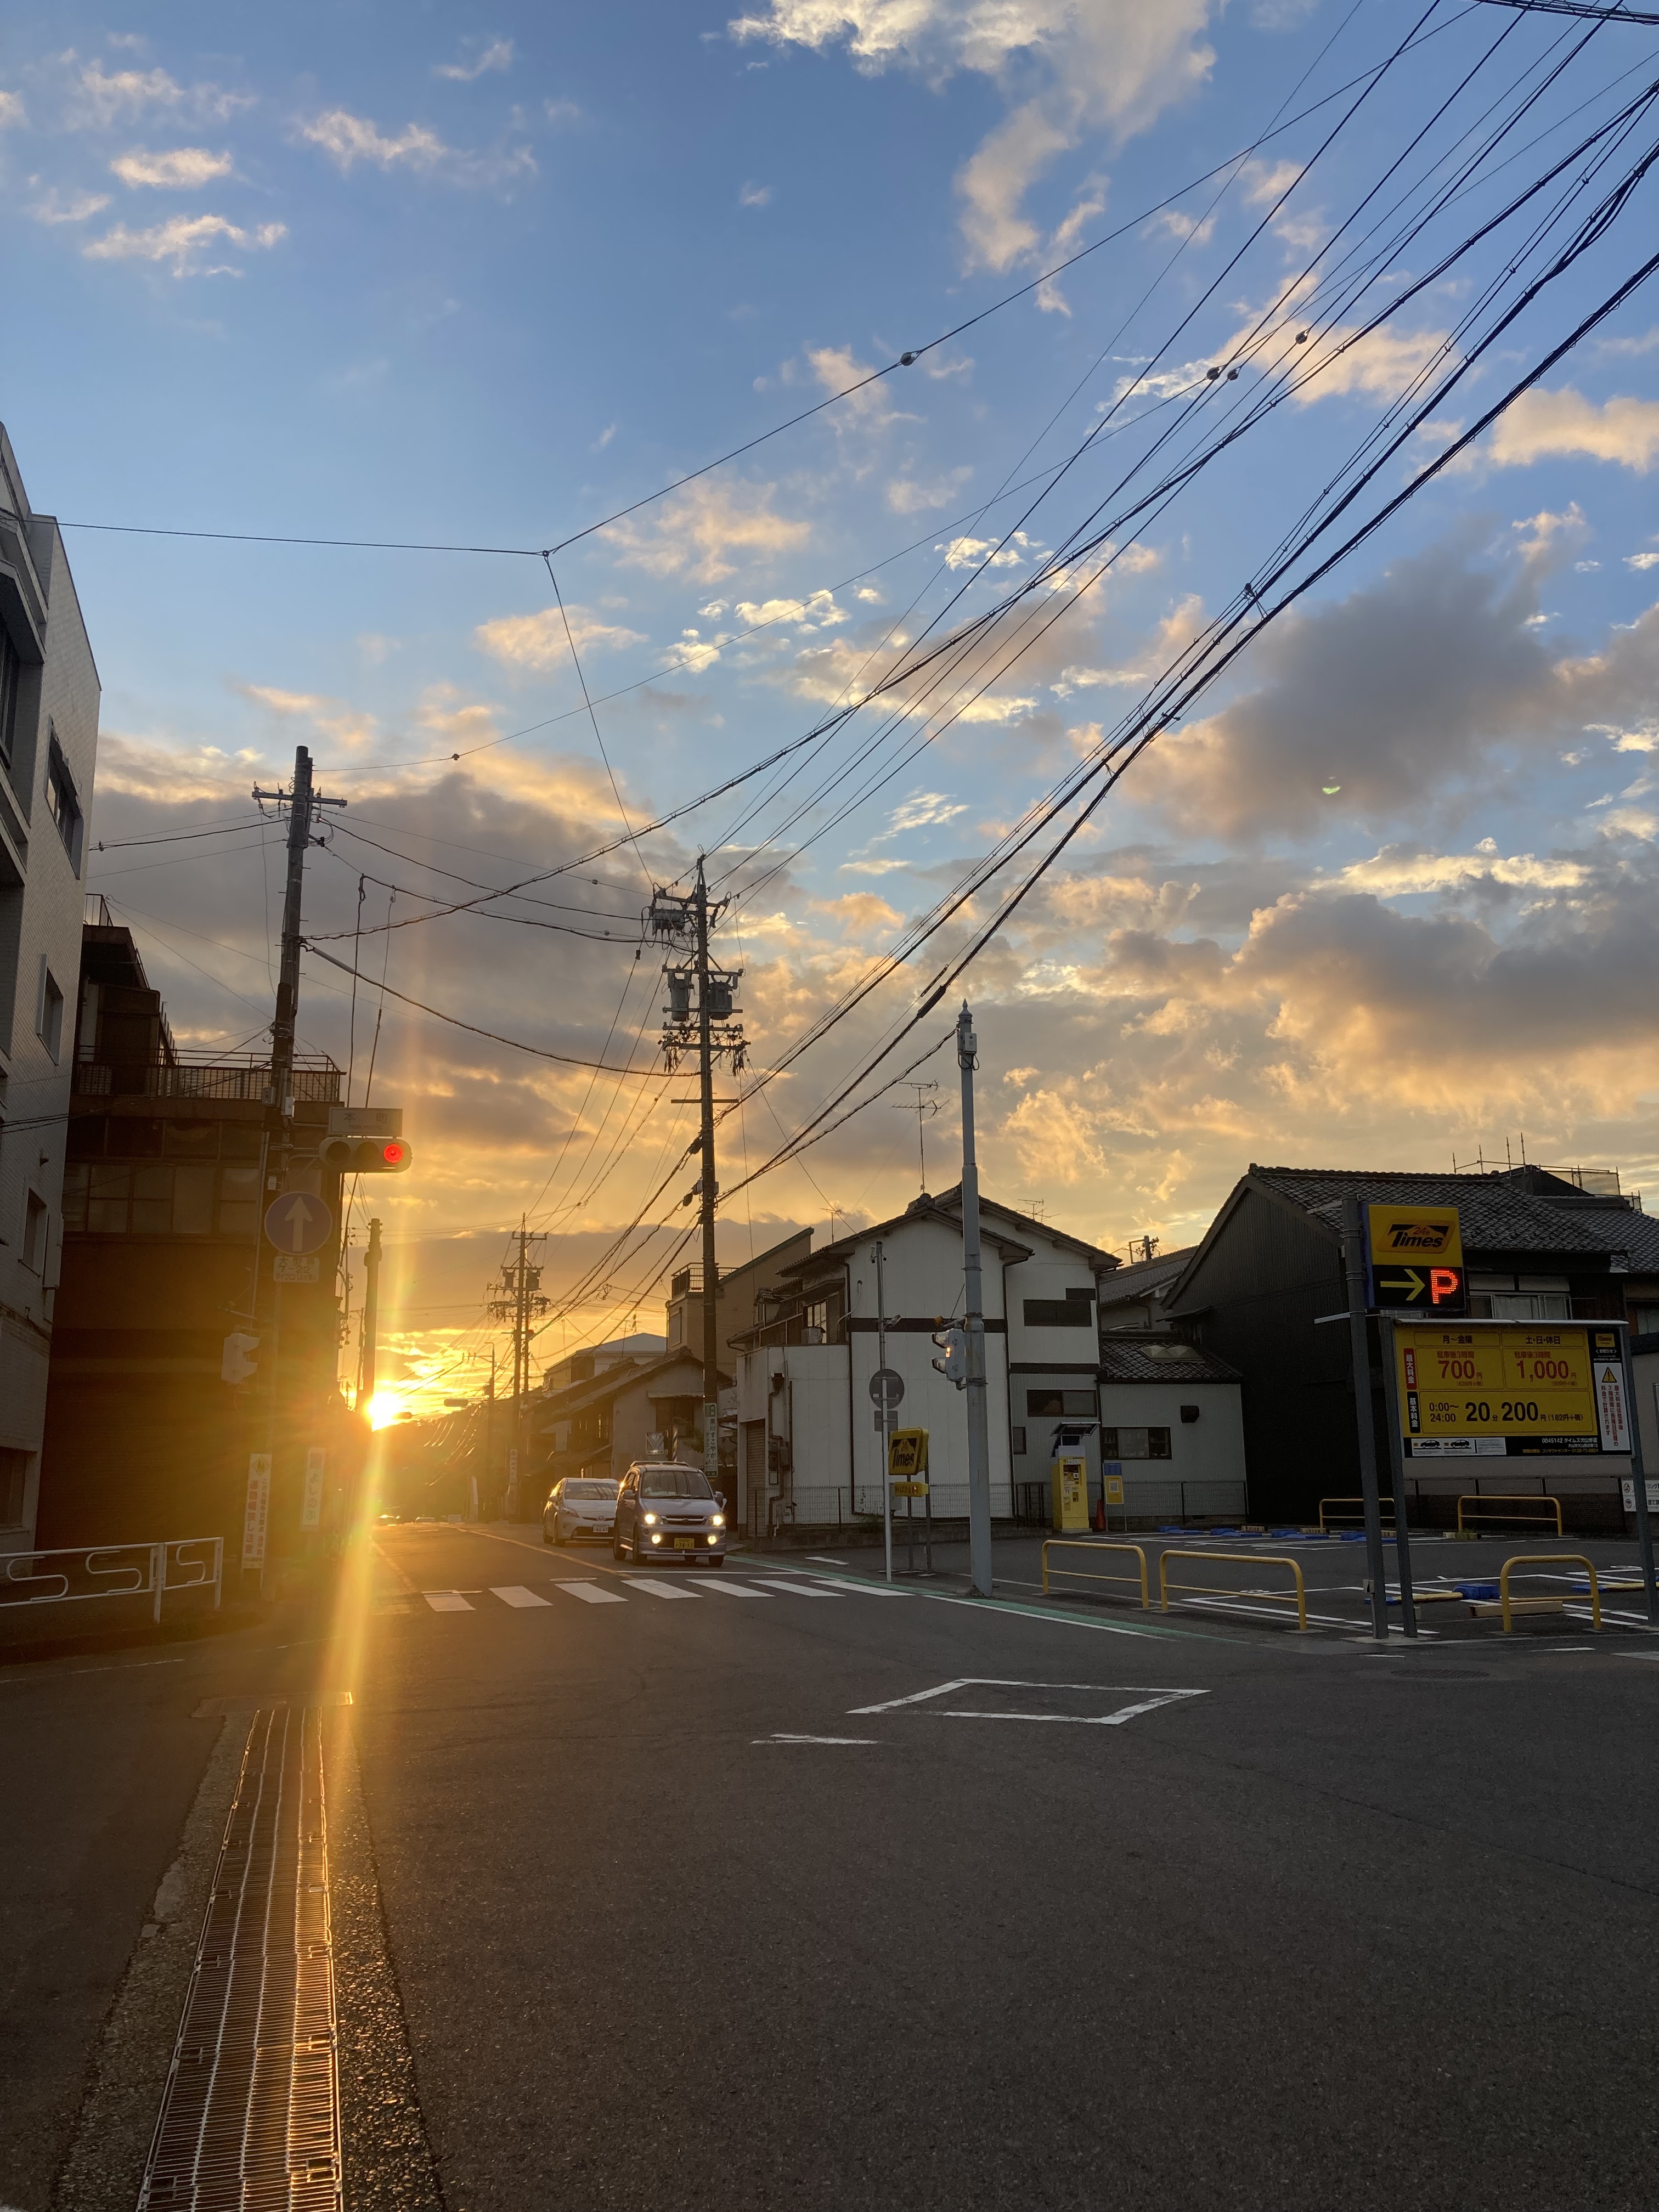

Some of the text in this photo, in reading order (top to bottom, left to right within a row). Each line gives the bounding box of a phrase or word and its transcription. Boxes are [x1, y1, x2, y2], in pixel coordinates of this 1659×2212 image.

[343, 1112, 387, 1124] 本町
[1391, 1231, 1444, 1248] Times
[278, 1265, 311, 1273] 7-22
[1430, 1269, 1459, 1304] P
[1406, 1353, 1415, 1384] 最大料金
[1409, 1397, 1419, 1427] 基本料金
[1430, 1413, 1456, 1423] 24:00
[892, 1448, 915, 1470] Times
